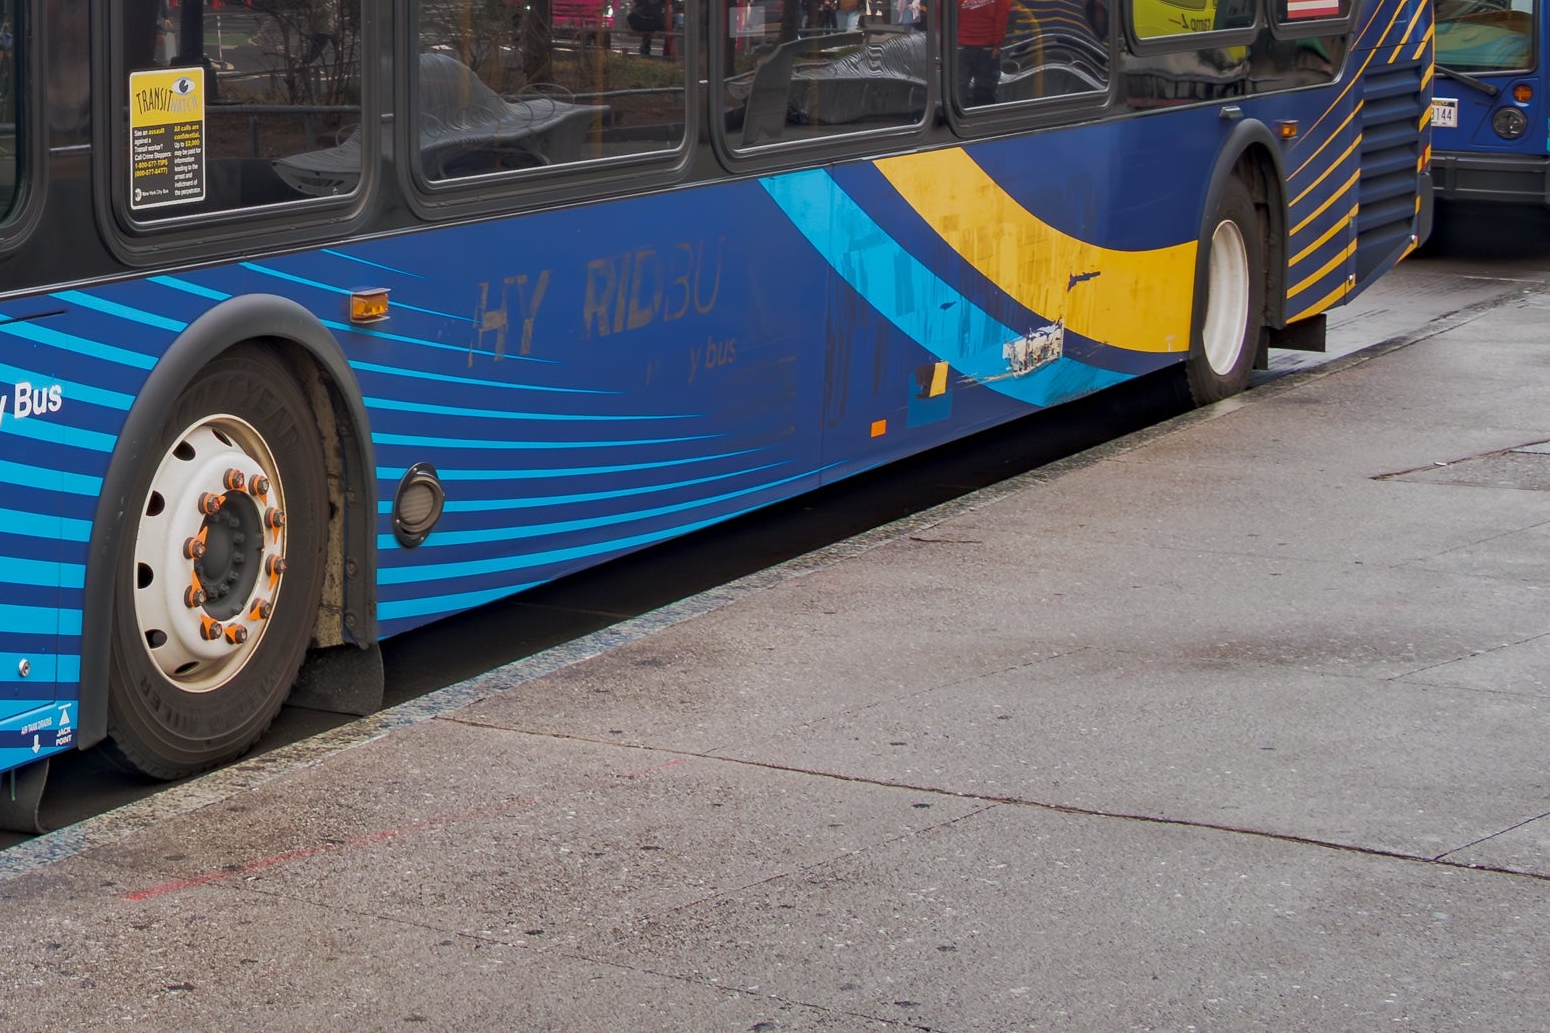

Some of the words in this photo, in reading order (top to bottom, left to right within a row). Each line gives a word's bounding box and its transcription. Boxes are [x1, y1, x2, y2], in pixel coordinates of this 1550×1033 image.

[136, 87, 173, 115] TRANSIT
[14, 381, 63, 419] Bus
[55, 734, 73, 747] POINT
